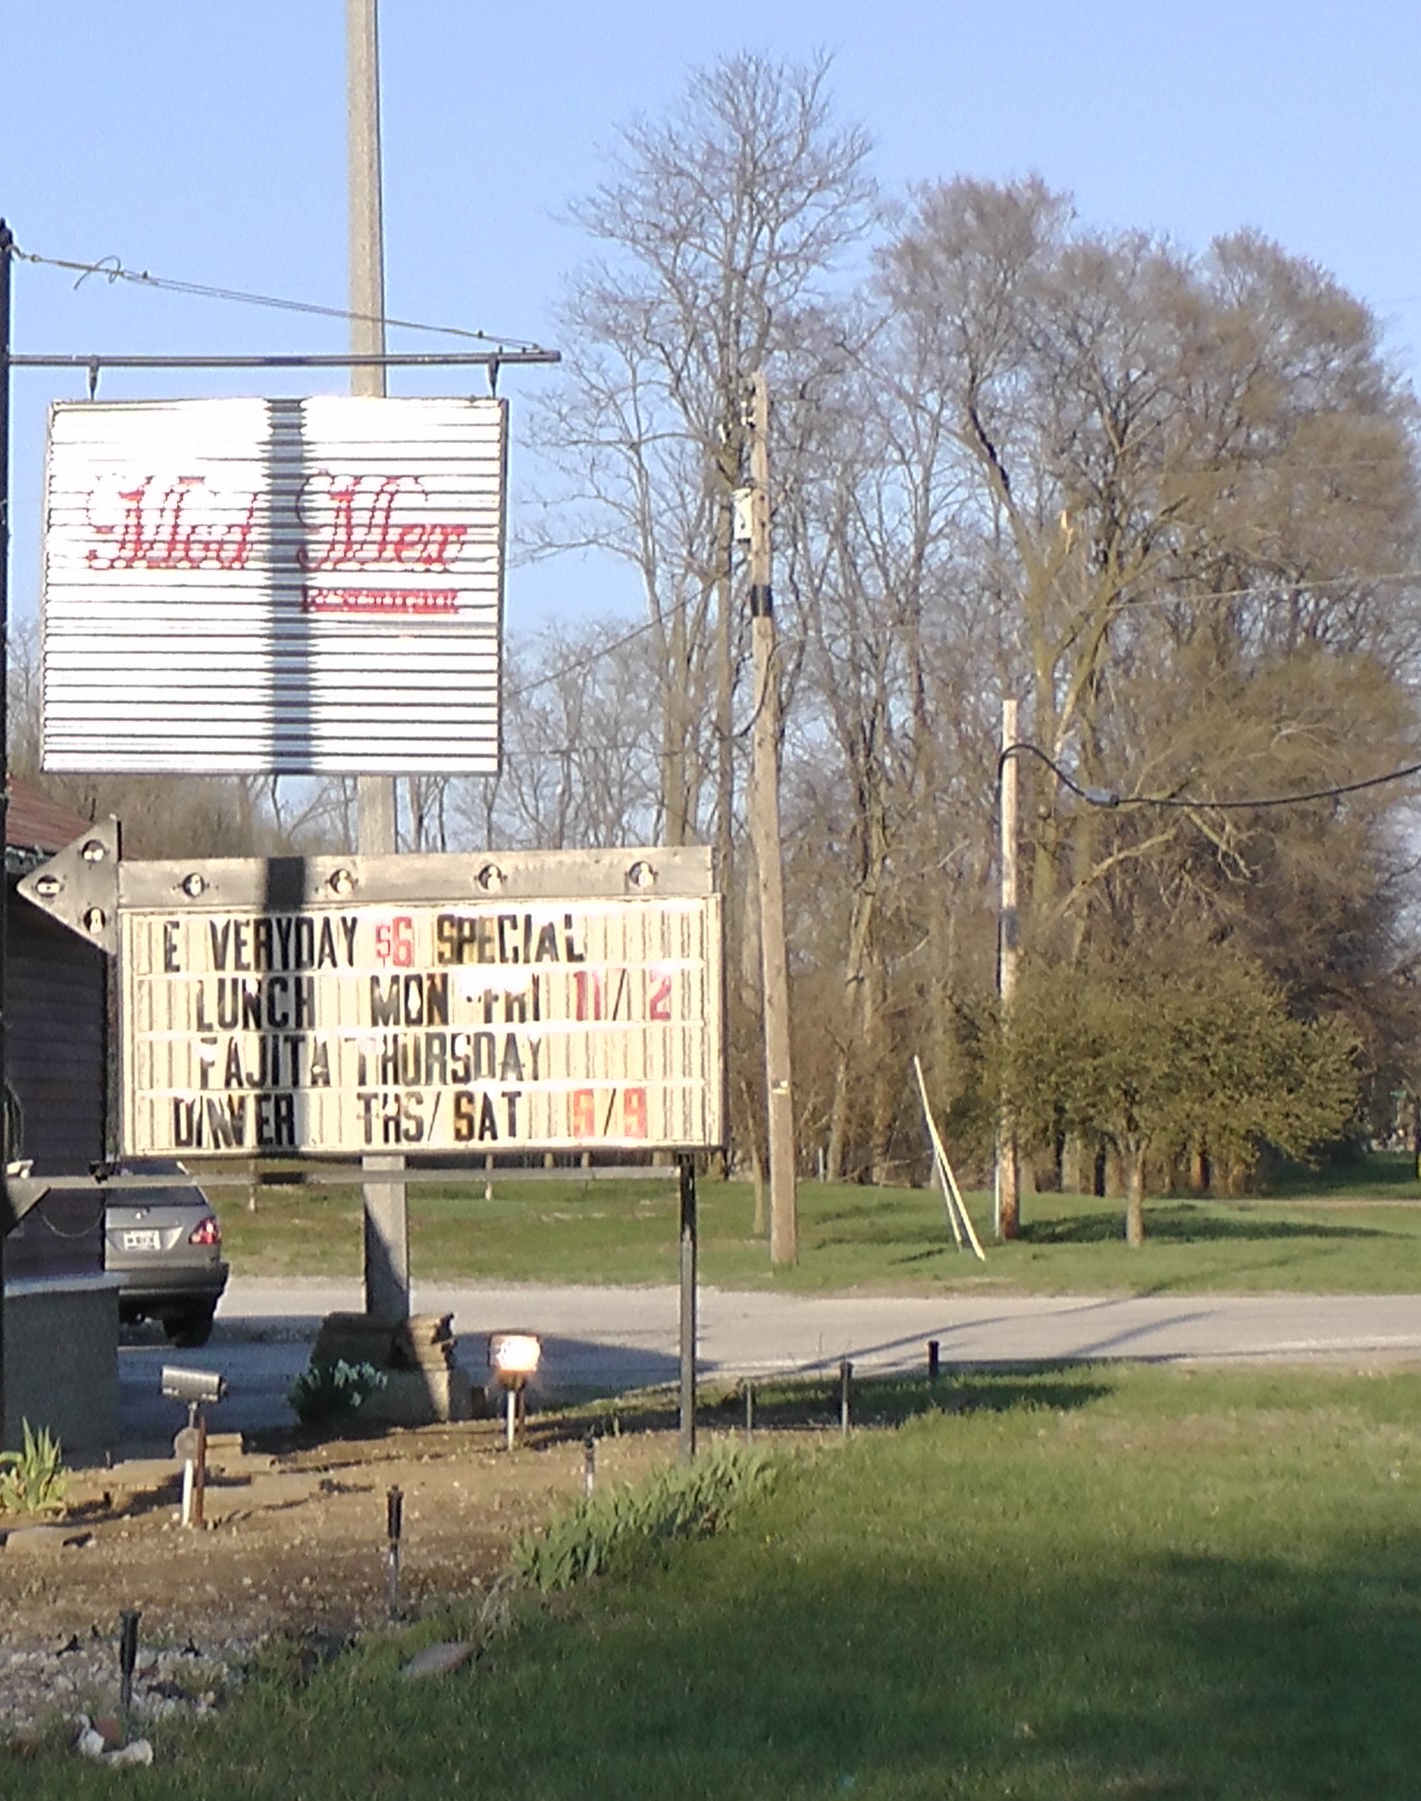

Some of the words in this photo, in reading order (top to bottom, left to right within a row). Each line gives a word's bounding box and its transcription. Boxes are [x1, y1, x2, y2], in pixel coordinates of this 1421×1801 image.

[374, 916, 413, 968] $6
[436, 913, 585, 964] SPECIAL
[196, 975, 316, 1033] LUNCH
[370, 972, 449, 1028] MON
[198, 1034, 331, 1089] FAJITA
[343, 1032, 542, 1088] THURSDAY
[173, 1093, 297, 1149] DINNER
